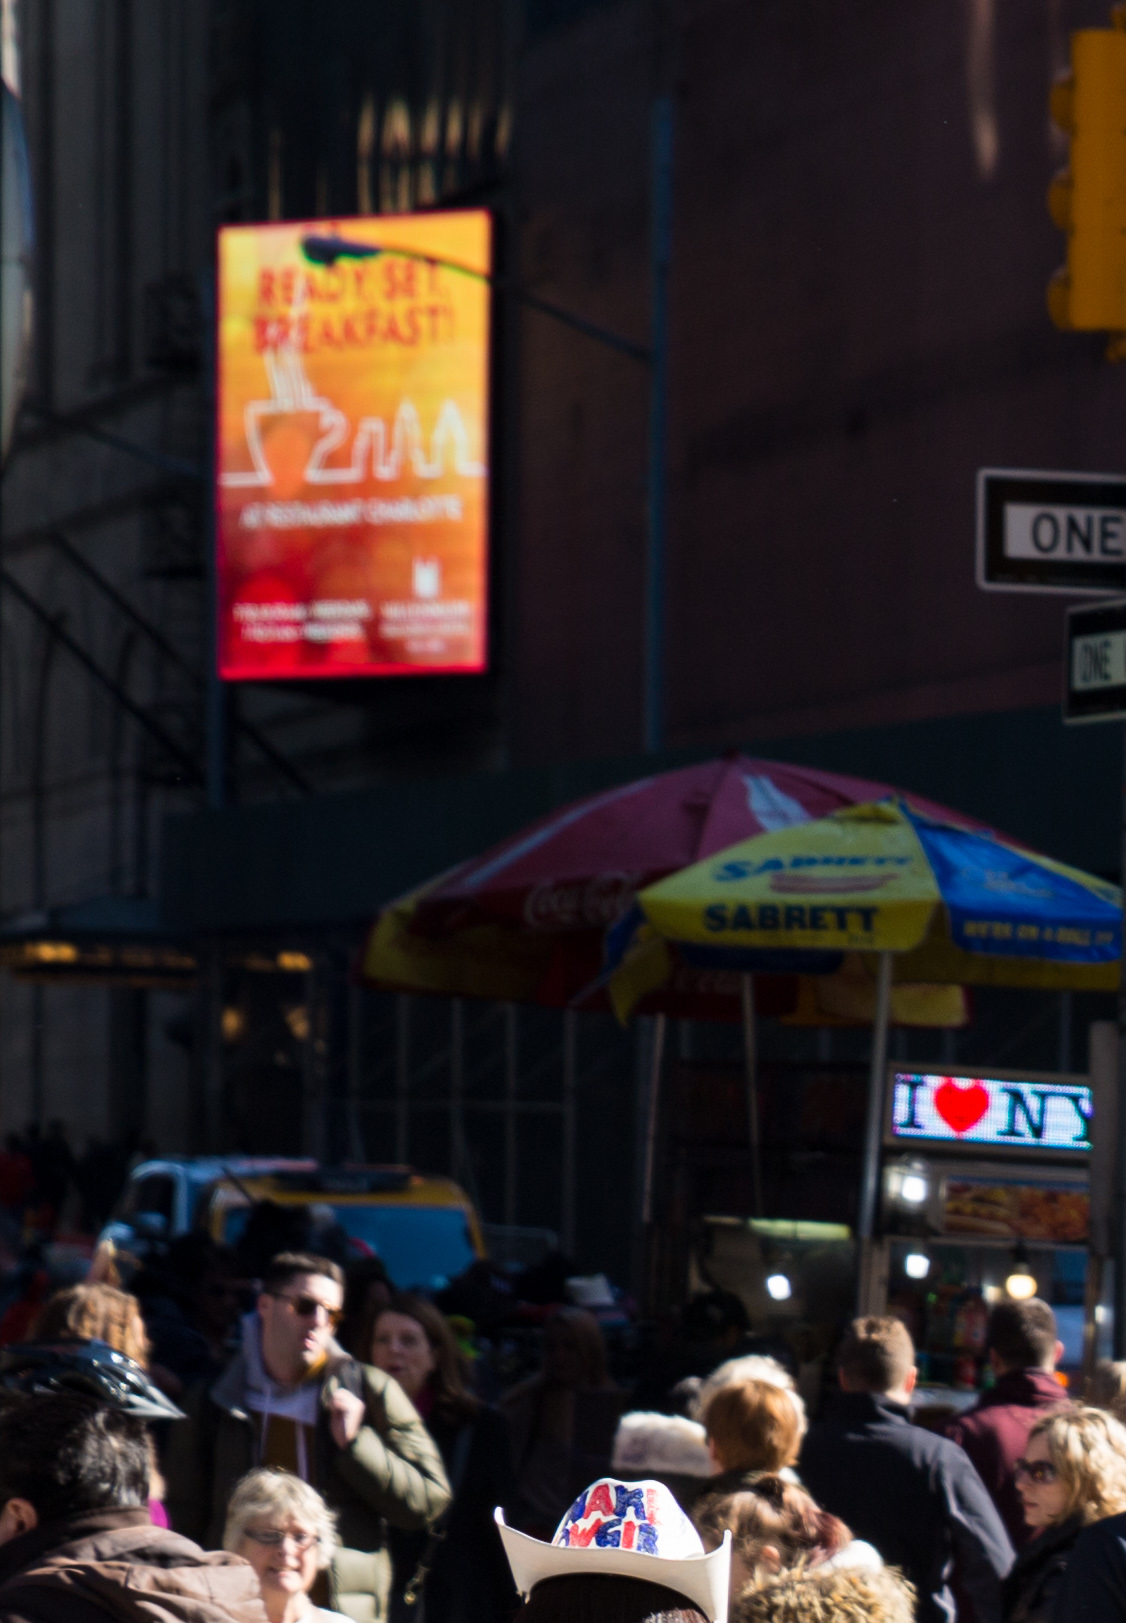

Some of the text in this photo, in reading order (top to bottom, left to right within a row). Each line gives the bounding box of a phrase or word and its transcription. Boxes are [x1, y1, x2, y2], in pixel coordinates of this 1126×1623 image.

[1031, 512, 1124, 556] ONE
[1081, 641, 1112, 682] ONE
[705, 903, 878, 932] SABRETT
[899, 1075, 924, 1129] I
